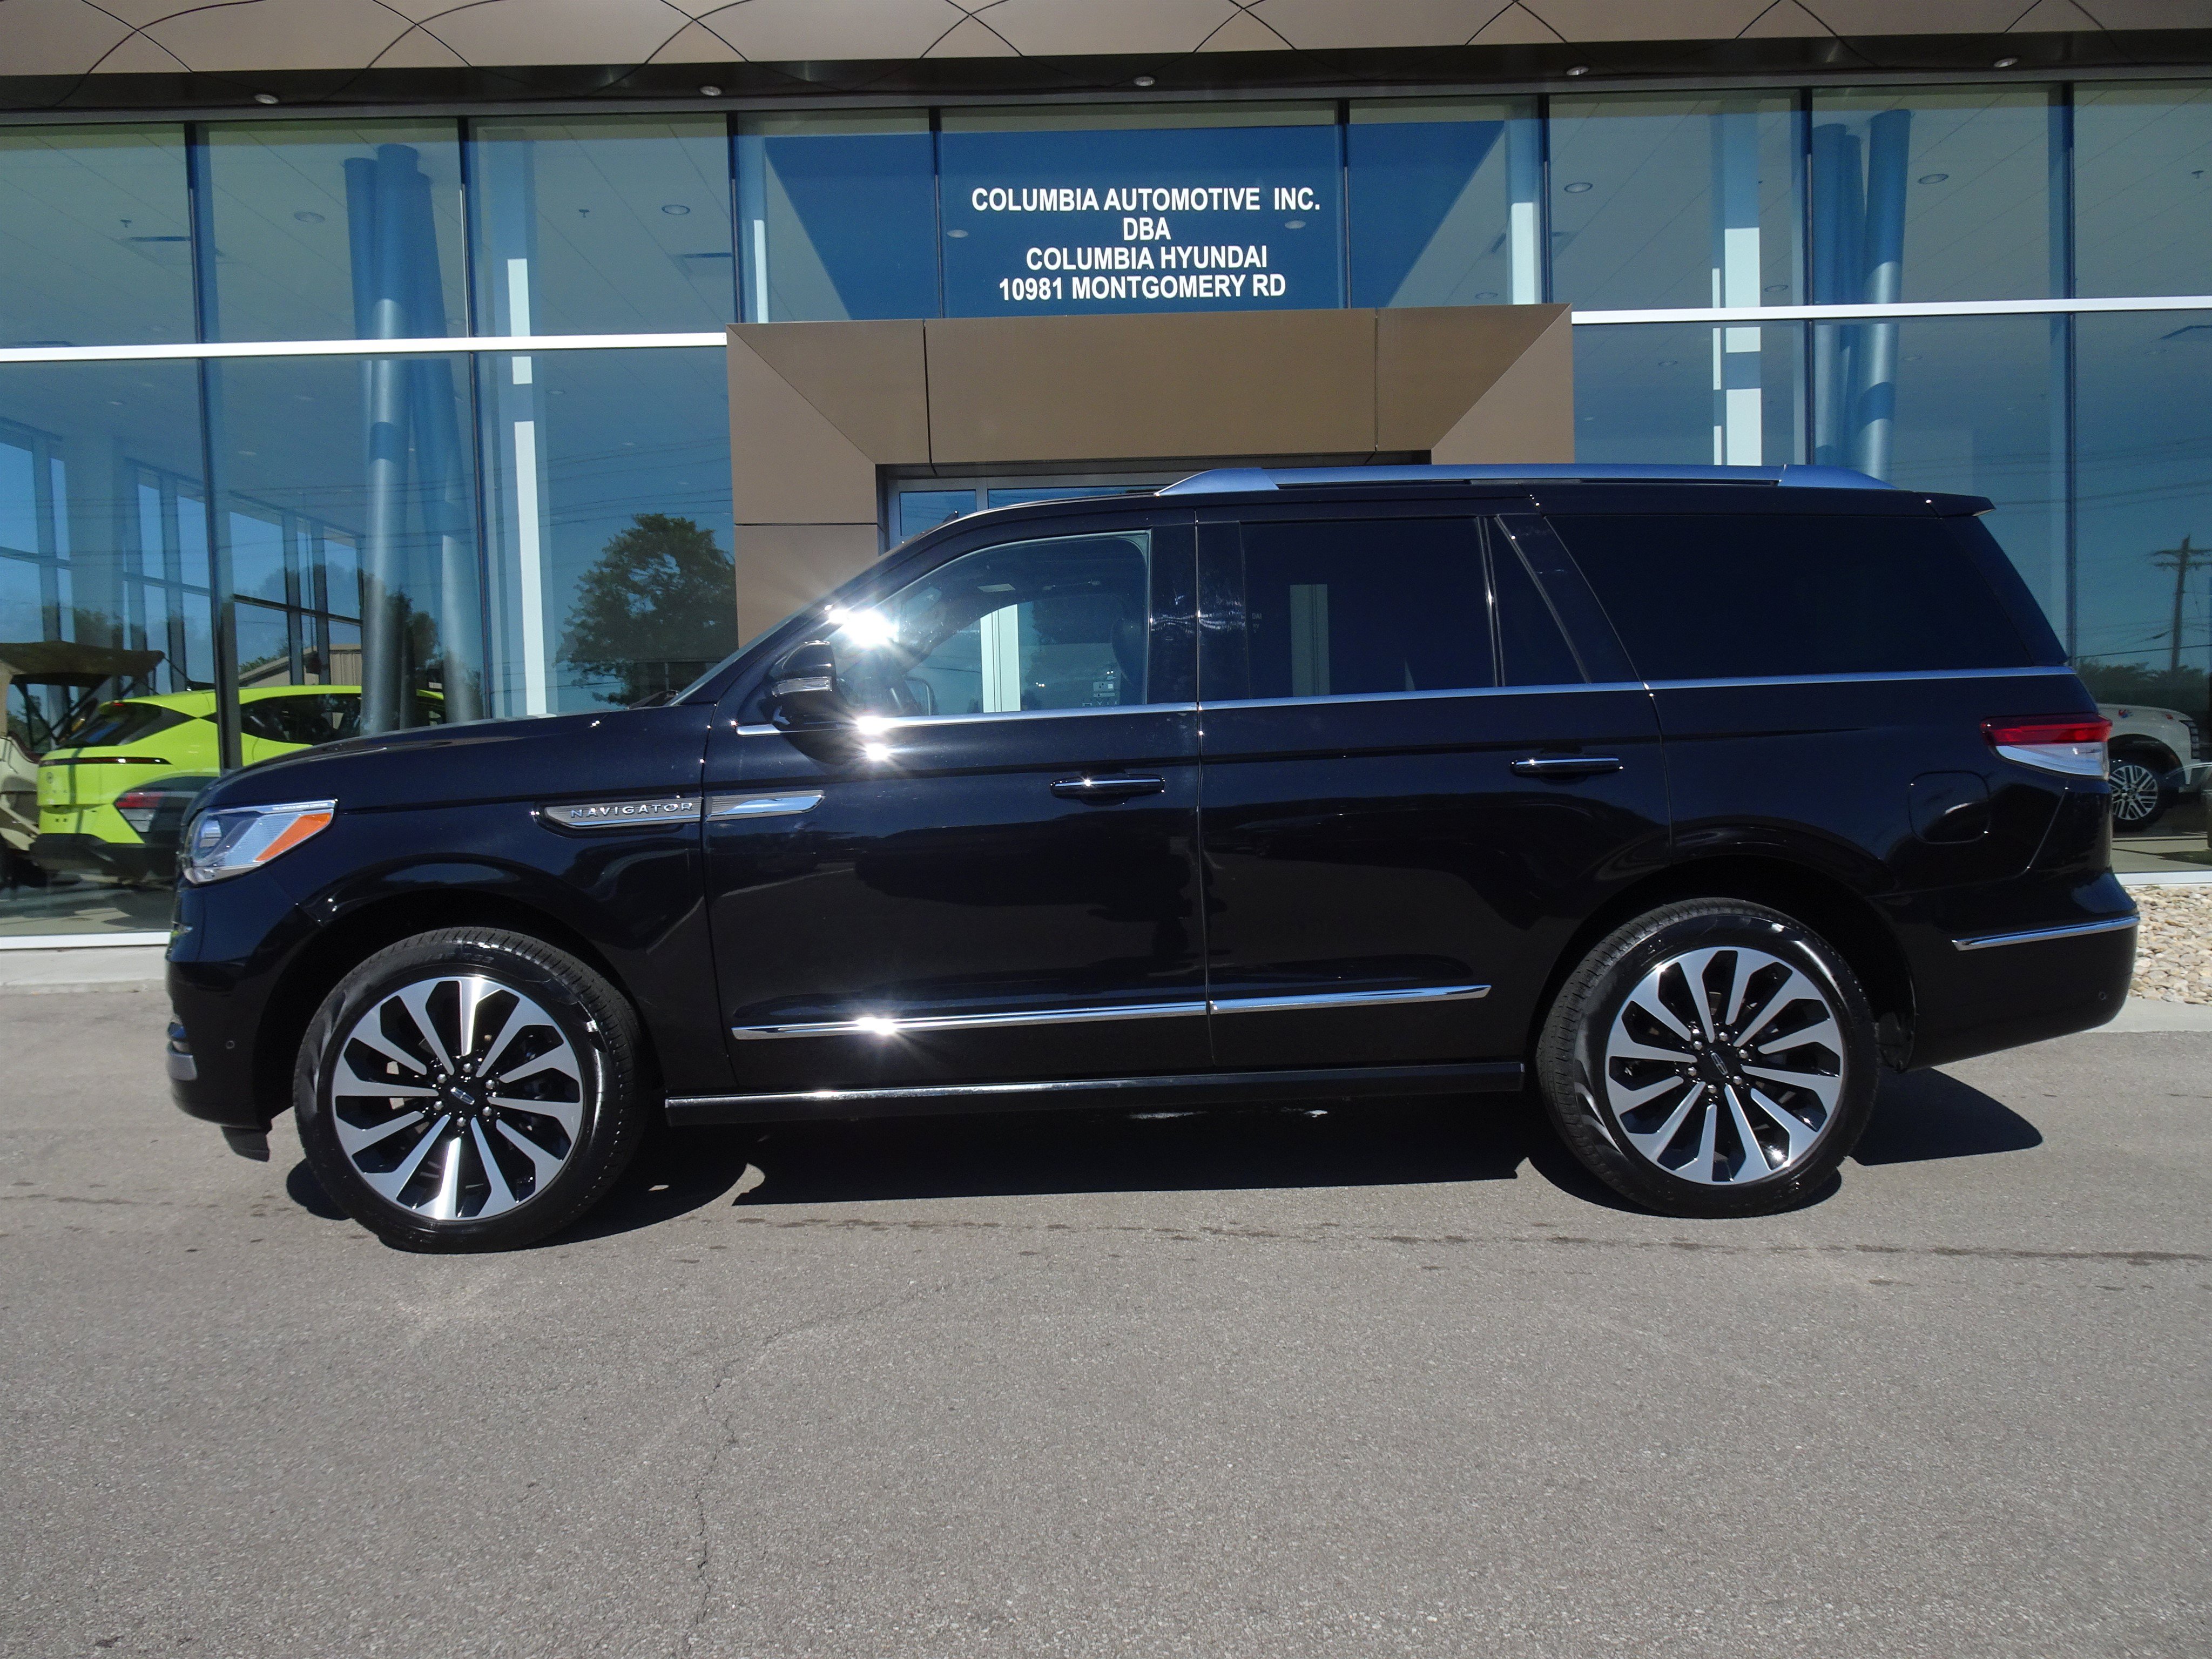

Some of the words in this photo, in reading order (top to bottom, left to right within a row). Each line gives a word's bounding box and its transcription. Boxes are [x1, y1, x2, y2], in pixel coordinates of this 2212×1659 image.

[972, 187, 1100, 211] COLUMBIA
[1103, 187, 1260, 212] AUTOMOTIVE
[1274, 187, 1320, 210] INC.
[1123, 217, 1171, 241] DBA
[1026, 247, 1155, 271] COLUMBIA
[1161, 245, 1267, 269] HYUNDAI
[999, 276, 1062, 301] 10981
[1072, 274, 1246, 299] MONTGOMERY
[1252, 273, 1286, 296] RD
[571, 802, 692, 818] NAVIGATOR
